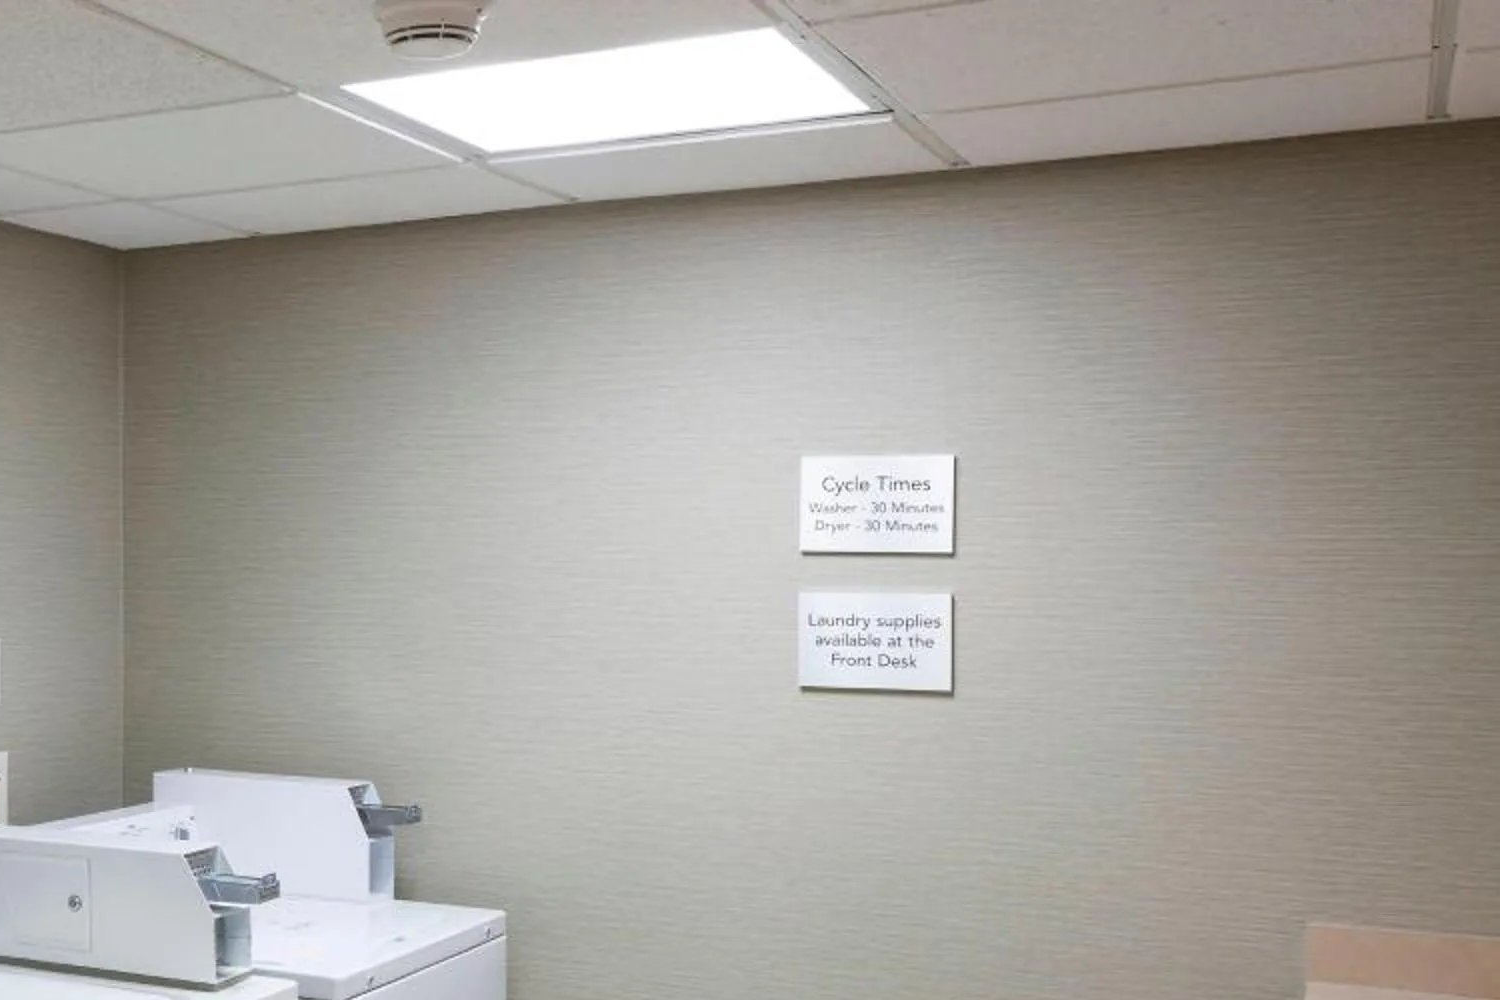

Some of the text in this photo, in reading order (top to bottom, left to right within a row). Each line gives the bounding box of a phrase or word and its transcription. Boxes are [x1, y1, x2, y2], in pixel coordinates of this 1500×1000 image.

[821, 474, 931, 496] Cycle Times
[808, 502, 857, 513] Washer
[871, 501, 887, 514] 30
[891, 501, 945, 513] Minutes
[814, 519, 851, 534] Dryer
[864, 519, 881, 532] 30
[885, 520, 939, 532] Minutes
[807, 612, 942, 632] Laundry supplies
[815, 632, 935, 649] available at the
[831, 652, 917, 669] Front Desk
